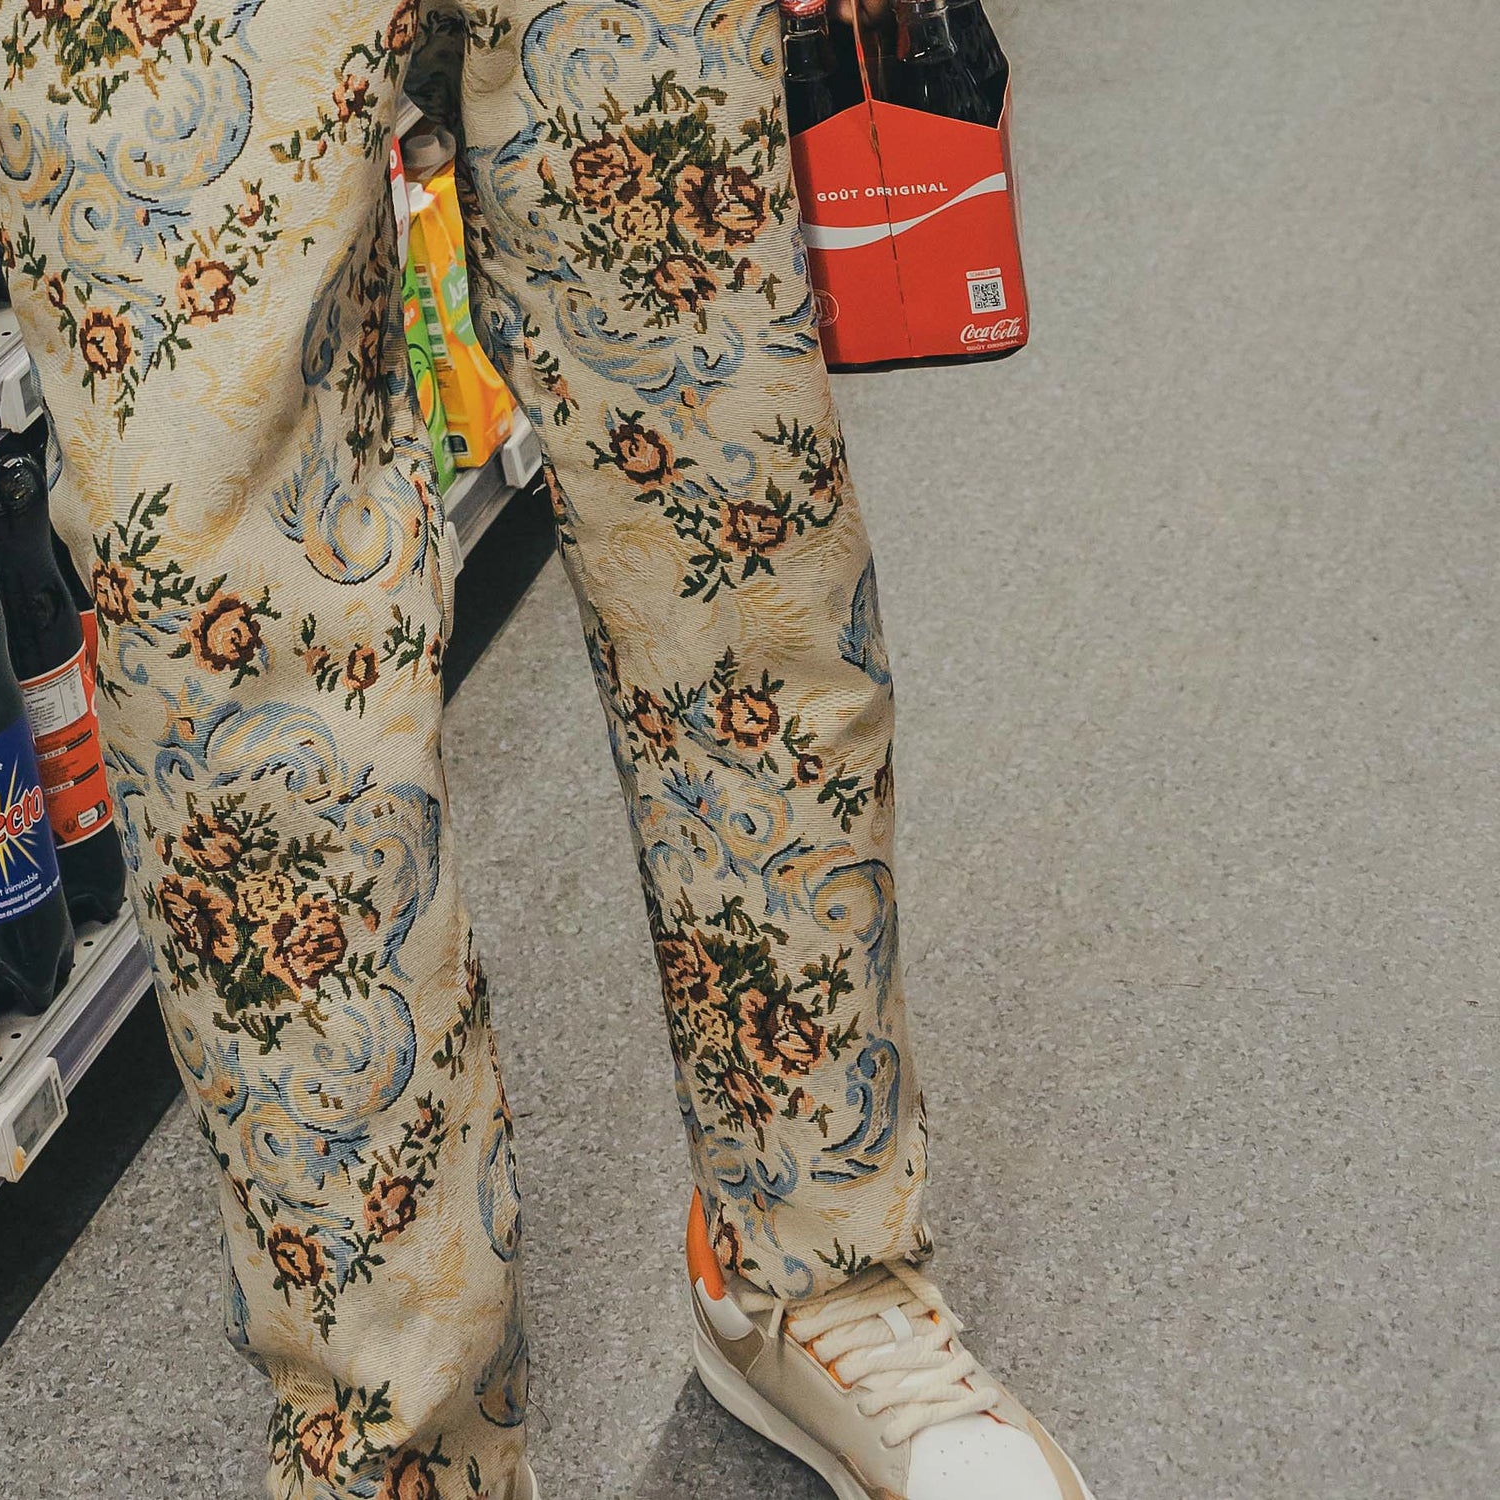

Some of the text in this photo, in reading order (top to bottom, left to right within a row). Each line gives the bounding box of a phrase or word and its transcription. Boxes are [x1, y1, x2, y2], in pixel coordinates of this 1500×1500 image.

[816, 182, 949, 203] GOÛT ORIGINAL
[959, 316, 1025, 345] Coca-Cola
